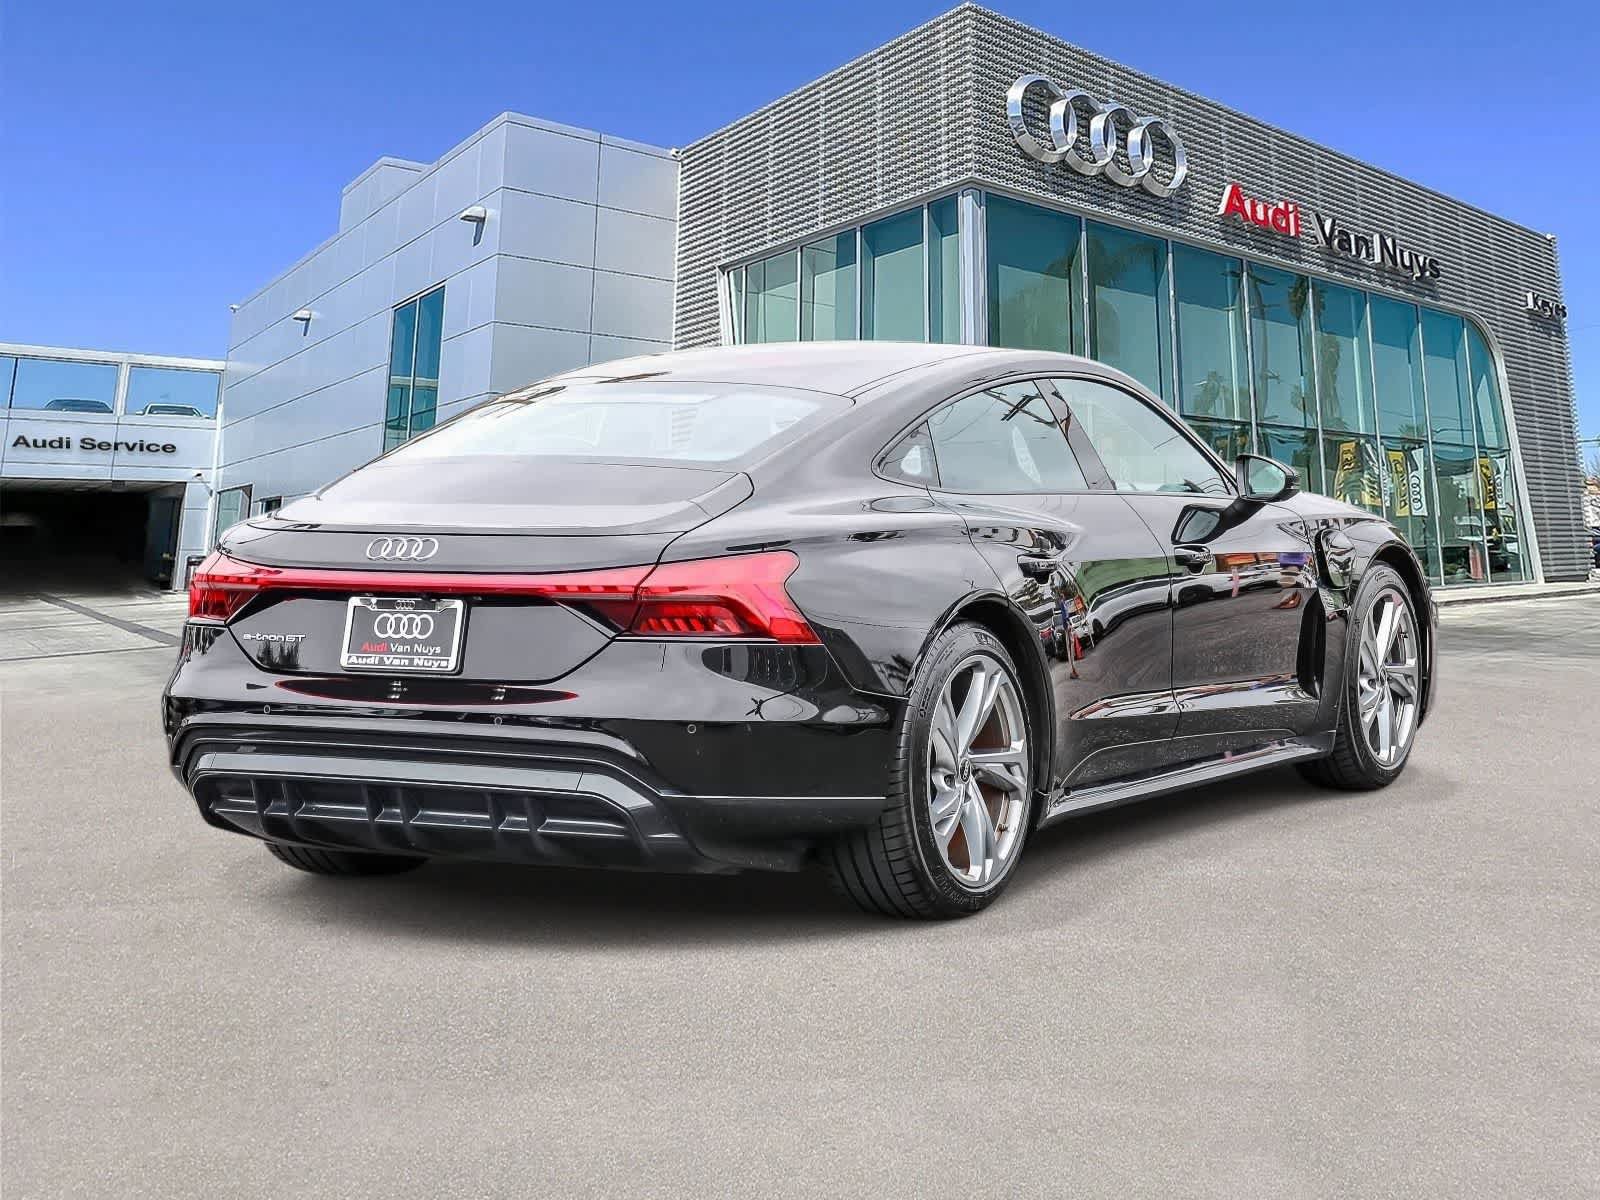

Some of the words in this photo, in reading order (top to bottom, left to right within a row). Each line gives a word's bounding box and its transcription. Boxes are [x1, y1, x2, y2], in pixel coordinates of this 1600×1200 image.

[1217, 183, 1302, 237] Audi
[1311, 212, 1370, 260] Van
[1373, 233, 1441, 281] Nuys
[12, 435, 71, 449] Audi
[80, 437, 177, 454] Service
[243, 632, 285, 642] e-tron
[362, 641, 387, 653] Audi
[390, 643, 411, 654] Van
[414, 644, 441, 655] Nuys
[348, 655, 380, 665] Audi
[383, 656, 409, 666] Van
[414, 657, 449, 668] Nuys
